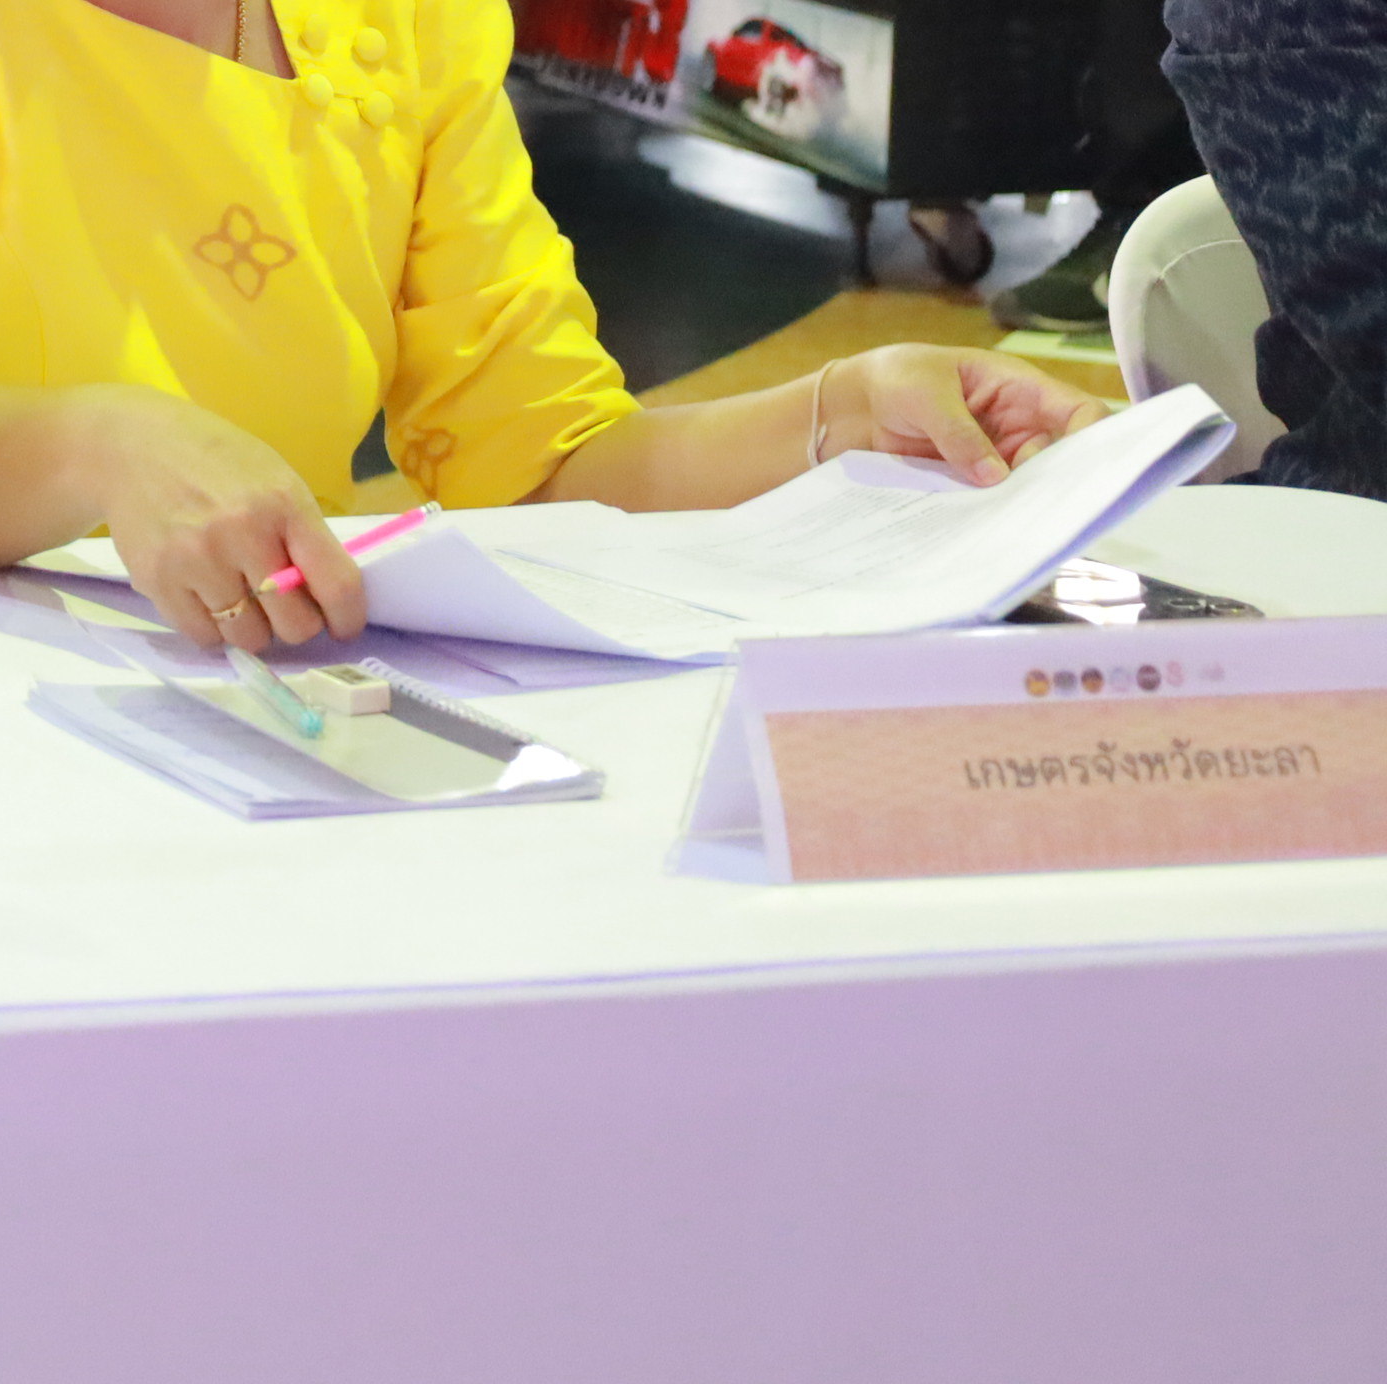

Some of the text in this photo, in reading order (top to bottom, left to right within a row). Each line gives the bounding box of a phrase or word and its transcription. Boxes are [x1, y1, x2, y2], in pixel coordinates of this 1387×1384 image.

[962, 737, 1322, 790] เกษตรจังหวัดยะลา
